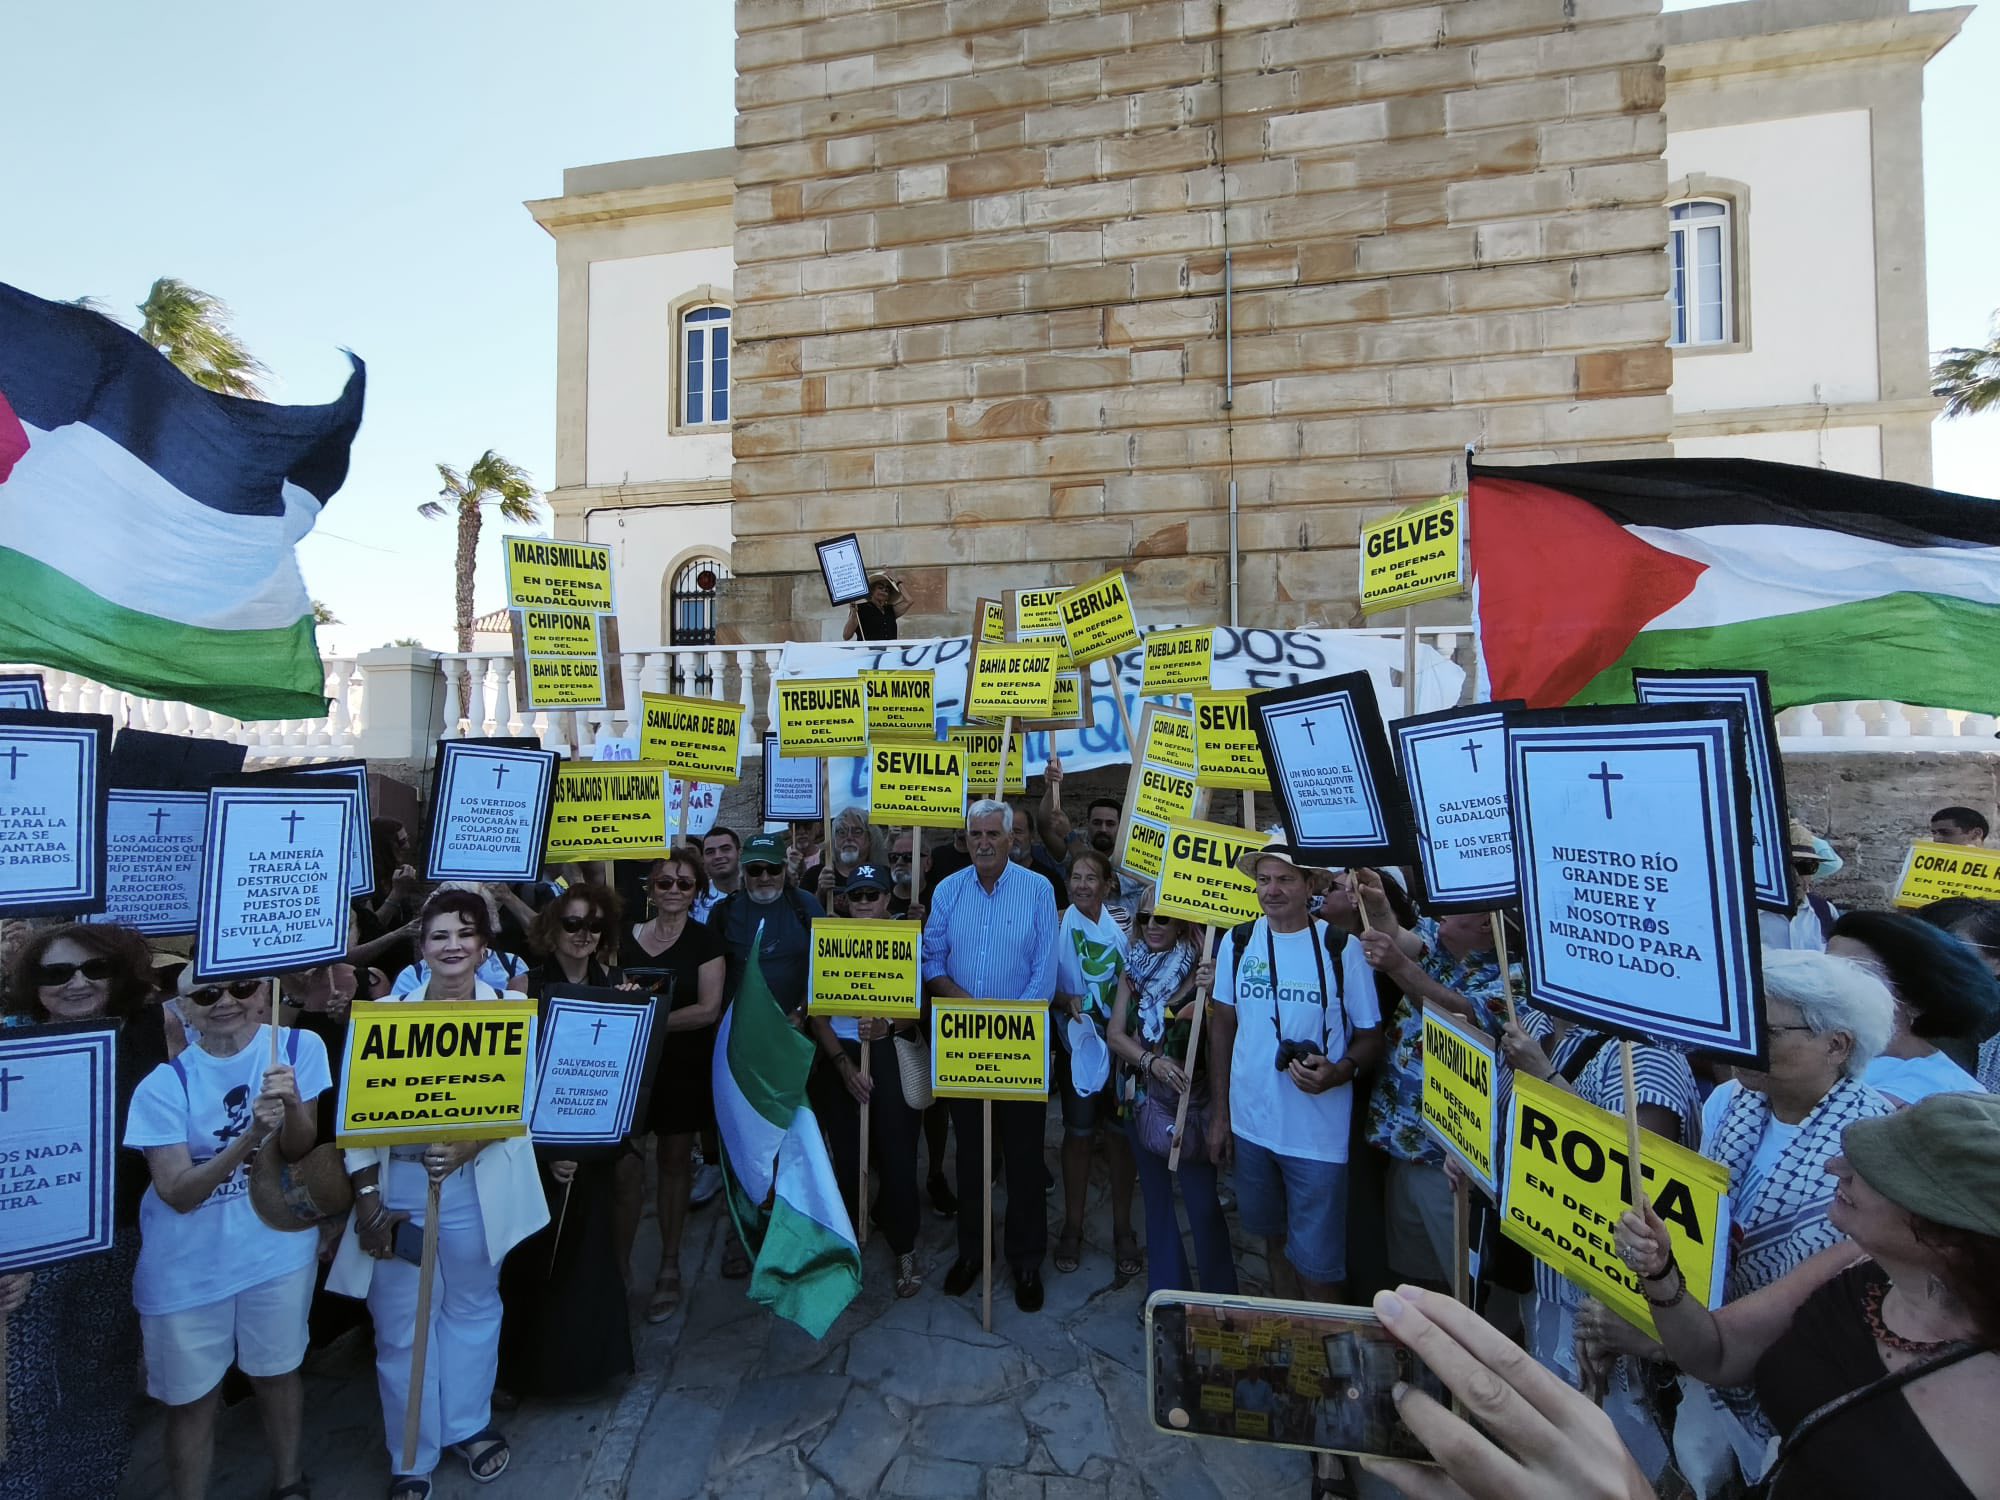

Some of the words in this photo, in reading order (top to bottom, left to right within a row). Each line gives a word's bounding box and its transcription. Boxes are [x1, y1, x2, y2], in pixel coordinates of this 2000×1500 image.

[1368, 510, 1454, 557] GELVES
[514, 543, 606, 570] MARISMILLAS
[1371, 567, 1386, 576] EN
[1390, 550, 1446, 571] DEFENSA
[1395, 570, 1417, 580] DEL
[546, 579, 602, 590] DEFENSA
[1364, 571, 1456, 598] GUADALQUIVIR
[515, 595, 611, 608] GUADALQUIVIR
[1062, 583, 1124, 624] LEBRIJA
[529, 613, 590, 630] CHIPIONA
[1086, 614, 1123, 632] DEFENSA
[1074, 629, 1134, 656] GUADALQUIVIR
[1148, 642, 1176, 658] PUEBLA
[1178, 640, 1192, 654] DEL
[1195, 635, 1209, 652] RÍO
[533, 662, 559, 676] BAHÍA
[562, 665, 571, 676] DE
[574, 662, 597, 676] CÁDIZ
[980, 656, 1006, 673] BAHÍA
[1009, 659, 1019, 672] DE
[1023, 655, 1050, 672] CÁDIZ
[1163, 661, 1202, 669] DEFENSA
[1145, 676, 1208, 686] GUADALQUIVIR
[892, 681, 930, 698] MAYOR
[783, 689, 860, 711] TREBUJENA
[647, 709, 698, 732] SANLÚCAR
[702, 717, 714, 734] DE
[717, 719, 735, 736] BDA
[1154, 721, 1174, 736] CORIA
[1176, 724, 1188, 739] DEL
[671, 741, 726, 752] DEFENSA
[784, 736, 864, 745] GUADALQUIVIR
[877, 752, 959, 776] SEVILLA
[1302, 768, 1316, 777] RÍO
[900, 784, 951, 792] DEFENSA
[1143, 771, 1193, 798] GELVES
[1293, 775, 1354, 788] GUADALQUIVIR
[567, 776, 601, 802] PALACIOS
[604, 776, 610, 801] Y
[611, 775, 659, 800] VILLAFRANCA
[1330, 787, 1341, 795] NO
[1344, 786, 1354, 794] TE
[481, 799, 526, 808] VERTIDOS
[874, 803, 960, 813] GUADALQUIVIR
[1154, 797, 1184, 810] DEFENSA
[1300, 797, 1342, 807] MOVILIZAS
[1439, 795, 1501, 812] SALVEMOS
[11, 807, 45, 815] PALI
[471, 807, 514, 816] MINEROS
[583, 813, 651, 821] DEFENSA
[49, 819, 66, 827] LA
[451, 815, 517, 826] PROVOCARÁN
[33, 831, 48, 839] SE
[461, 825, 504, 833] COLAPSO
[456, 834, 502, 843] ESTUARIO
[551, 836, 663, 846] GUADALQUIVIR
[1434, 840, 1449, 849] DE
[1455, 836, 1477, 847] LOS
[249, 852, 266, 860] LA
[270, 848, 324, 859] MINERÍA
[449, 843, 520, 852] GUADALQUIVIR
[1460, 845, 1512, 859] MINEROS
[10, 854, 73, 864] BARBOS.
[1552, 847, 1636, 868] NUESTRO
[1642, 851, 1678, 872] RÍO
[249, 860, 301, 873] TRAERÁ
[304, 862, 320, 870] LA
[1915, 856, 1957, 873] CORIA
[1961, 862, 1987, 878] DEL
[238, 872, 327, 886] DESTRUCCIÓN
[1562, 867, 1639, 889] GRANDE
[1644, 877, 1668, 893] SE
[247, 886, 299, 898] MASIVA
[303, 885, 318, 894] DE
[1202, 889, 1228, 901] DEL
[243, 897, 302, 910] PUESTOS
[305, 896, 320, 905] DE
[1574, 888, 1639, 909] MUERE
[1646, 898, 1656, 912] Y
[241, 910, 302, 923] TRABAJO
[305, 908, 321, 917] EN
[222, 924, 282, 938] SEVILLA,
[286, 918, 333, 931] HUELVA
[253, 938, 260, 947] Y
[818, 935, 873, 959] SANLÚCAR
[876, 940, 889, 959] DE
[892, 942, 912, 960] BDA
[1550, 921, 1634, 949] MIRANDO
[1641, 937, 1702, 962] PARA
[1566, 943, 1614, 965] OTRO
[1619, 955, 1681, 979] LADO.
[844, 971, 904, 980] DEFENSA
[851, 982, 874, 990] DEL
[816, 992, 914, 1003] GUADALQUIVIR
[941, 1014, 1035, 1041] CHIPIONA
[361, 1022, 523, 1061] ALMONTE
[968, 1052, 1031, 1061] DEFENSA
[1426, 1022, 1488, 1097] MARISMILLAS
[558, 1058, 605, 1069] SALVEMOS
[607, 1060, 617, 1068] EL
[976, 1064, 1000, 1072] DEL
[551, 1068, 619, 1078] GUADALQUIVIR
[366, 1078, 396, 1088] EN
[405, 1074, 506, 1086] DEFENSA
[939, 1075, 1042, 1085] GUADALQUIVIR
[416, 1092, 456, 1102] DEL
[555, 1088, 566, 1096] EL
[568, 1088, 608, 1096] TURISMO
[551, 1097, 594, 1106] ANDALUZ
[596, 1098, 607, 1106] EN
[1430, 1076, 1441, 1091] EN
[1444, 1085, 1482, 1132] DEFENSA
[351, 1105, 520, 1122] GUADALQUIVIR
[1447, 1107, 1462, 1129] DEL
[1424, 1101, 1489, 1171] GUADALQUIVIR
[25, 1142, 83, 1160] NADA
[10, 1166, 37, 1178] LA
[56, 1171, 82, 1185] EN
[1520, 1104, 1703, 1245] ROTA
[1525, 1172, 1554, 1199] EN
